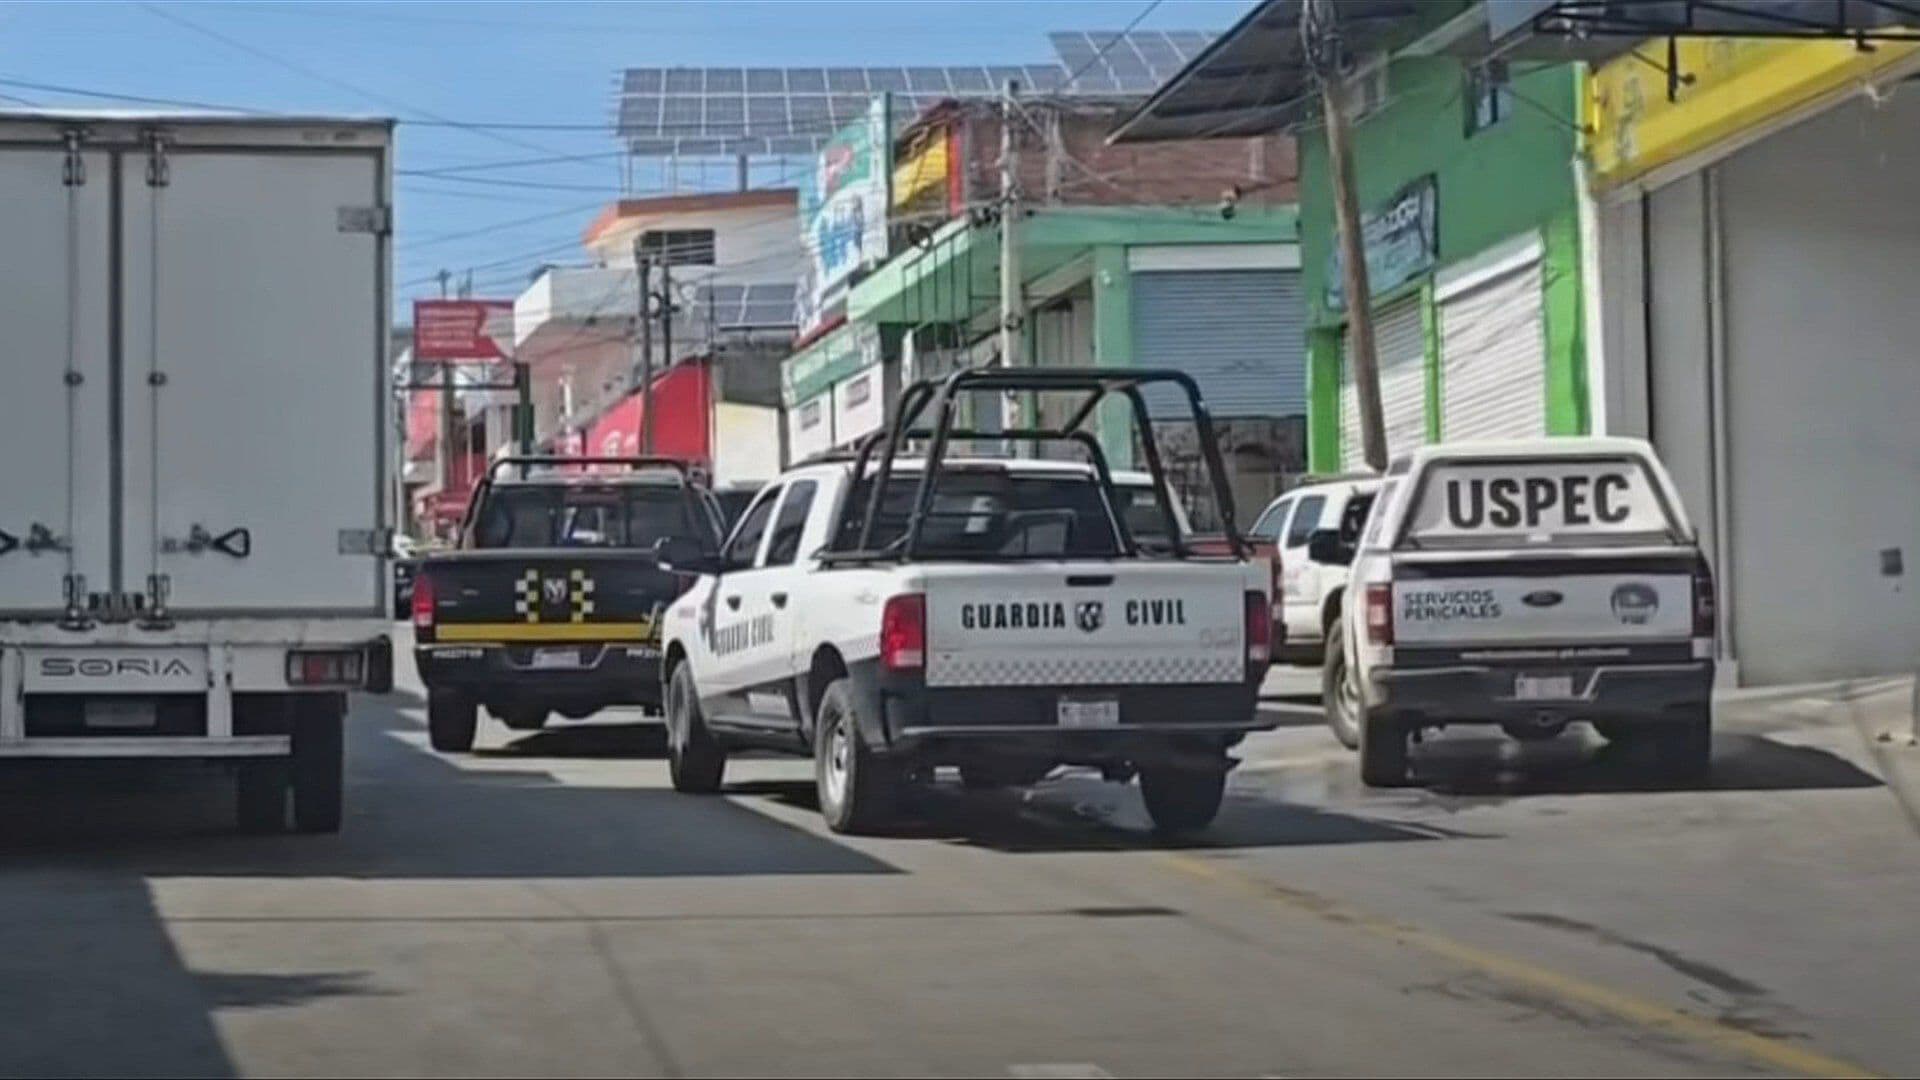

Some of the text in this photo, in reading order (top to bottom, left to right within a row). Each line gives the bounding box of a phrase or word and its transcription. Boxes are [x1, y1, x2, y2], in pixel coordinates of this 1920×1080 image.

[1447, 474, 1631, 528] USPEC
[1404, 591, 1493, 606] SERVICIOS
[962, 600, 1186, 629] GUARDIA CIVIL
[1405, 605, 1502, 621] PERICIALES
[41, 658, 191, 676] SORIA
